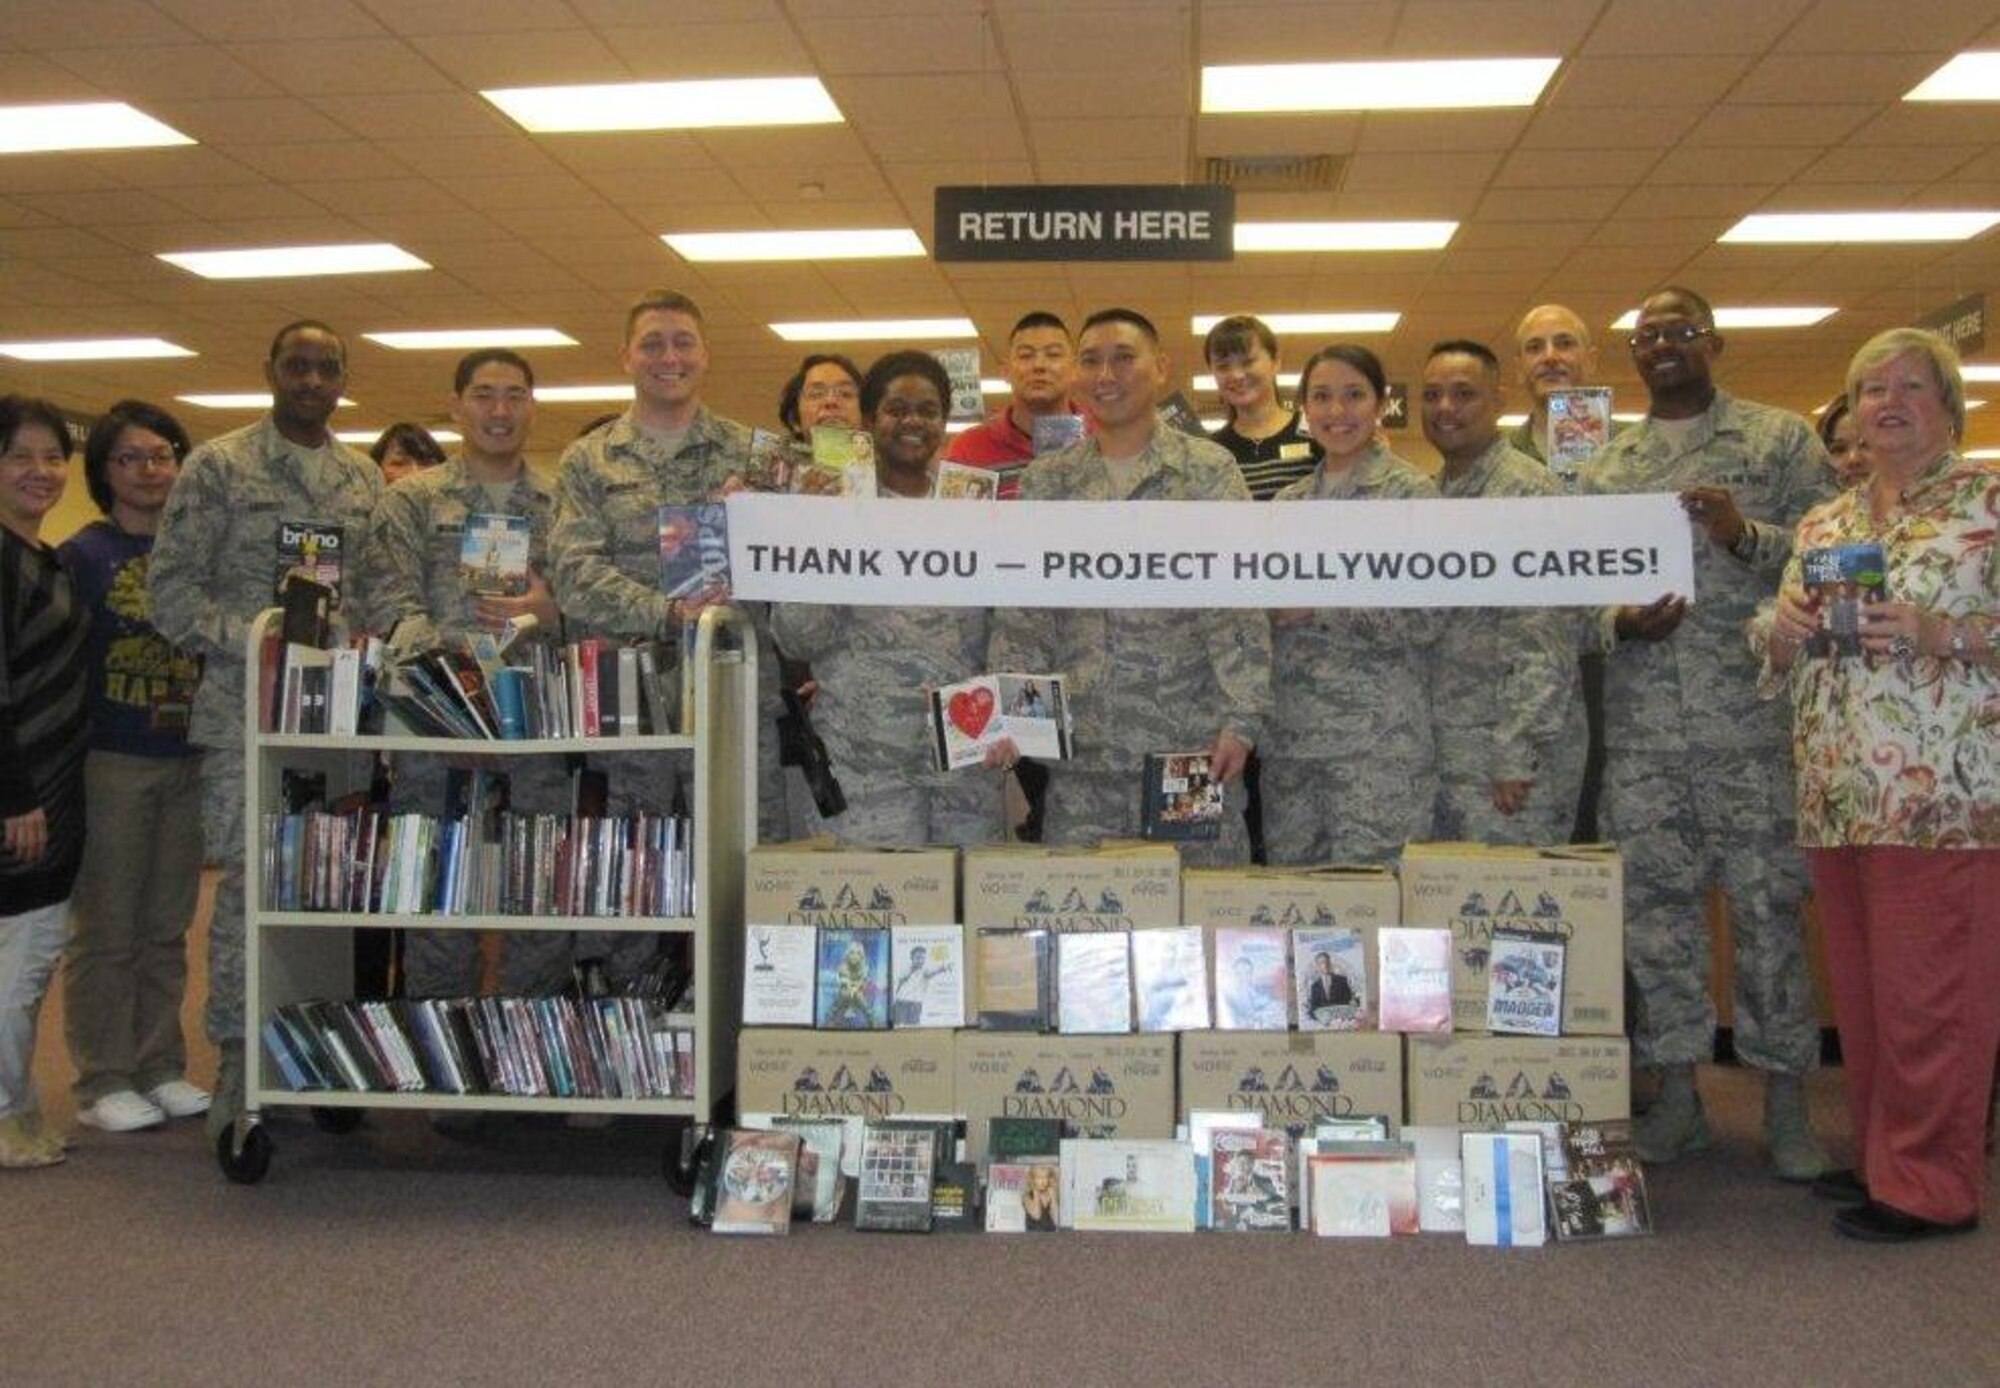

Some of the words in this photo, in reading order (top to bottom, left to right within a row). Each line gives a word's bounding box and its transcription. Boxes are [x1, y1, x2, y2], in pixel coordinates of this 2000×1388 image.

[958, 211, 1103, 241] RETURN
[1114, 211, 1211, 241] HERE
[747, 544, 882, 577] THANK
[897, 549, 978, 578] YOU
[1043, 550, 1217, 580] PROJECT
[1233, 551, 1496, 581] HOLLYWOOD
[1512, 547, 1660, 578] CARES!
[782, 1092, 906, 1118] DIAMOND
[1002, 1096, 1128, 1119] DIAMOND
[1226, 1092, 1354, 1117] DIAMOND
[1457, 1101, 1584, 1126] DIAMOND
